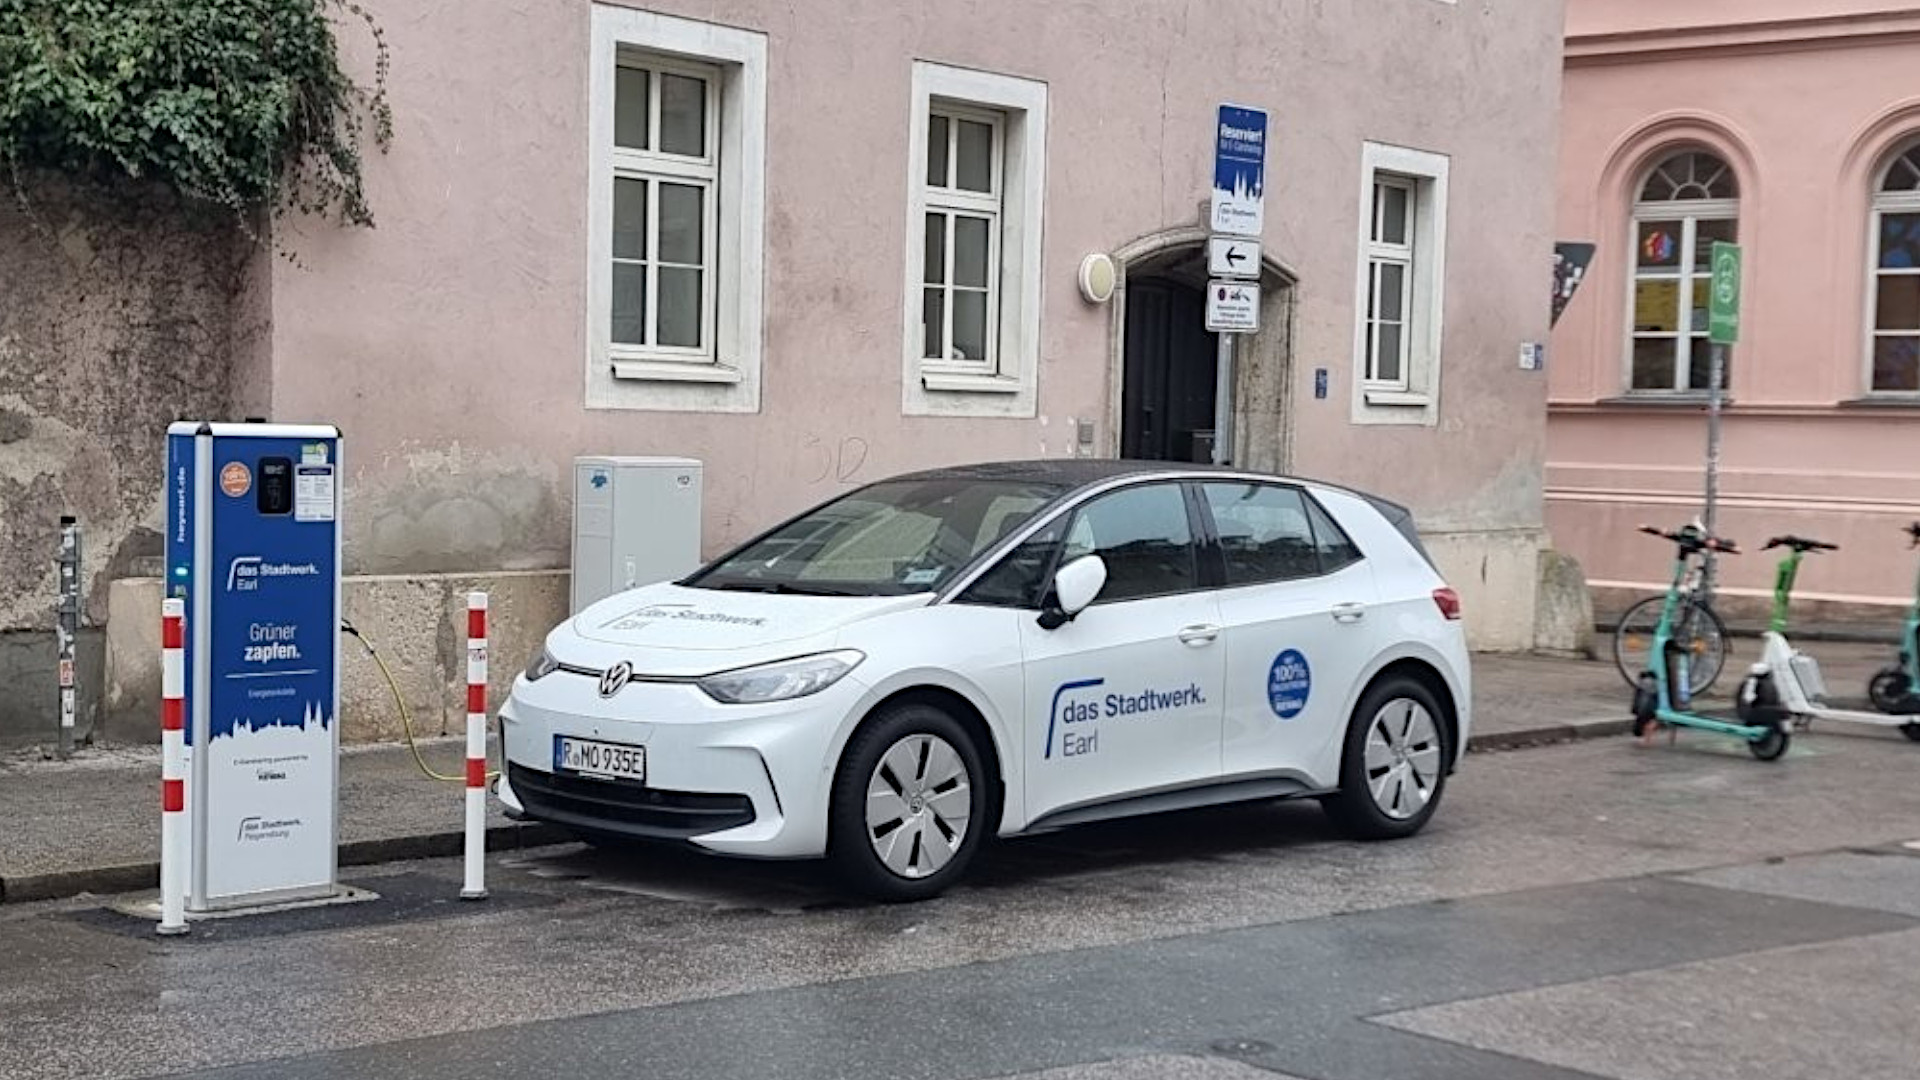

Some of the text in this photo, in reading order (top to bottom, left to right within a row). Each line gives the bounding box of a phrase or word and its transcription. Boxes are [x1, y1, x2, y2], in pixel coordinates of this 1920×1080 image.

[236, 562, 320, 577] das Stadtwerk.
[236, 578, 258, 591] Earl
[249, 622, 297, 641] Grüner
[244, 643, 302, 664] zapfen.
[1274, 662, 1306, 681] 100%
[1063, 684, 1207, 724] das Stadtwerk.
[1062, 728, 1099, 757] Earl
